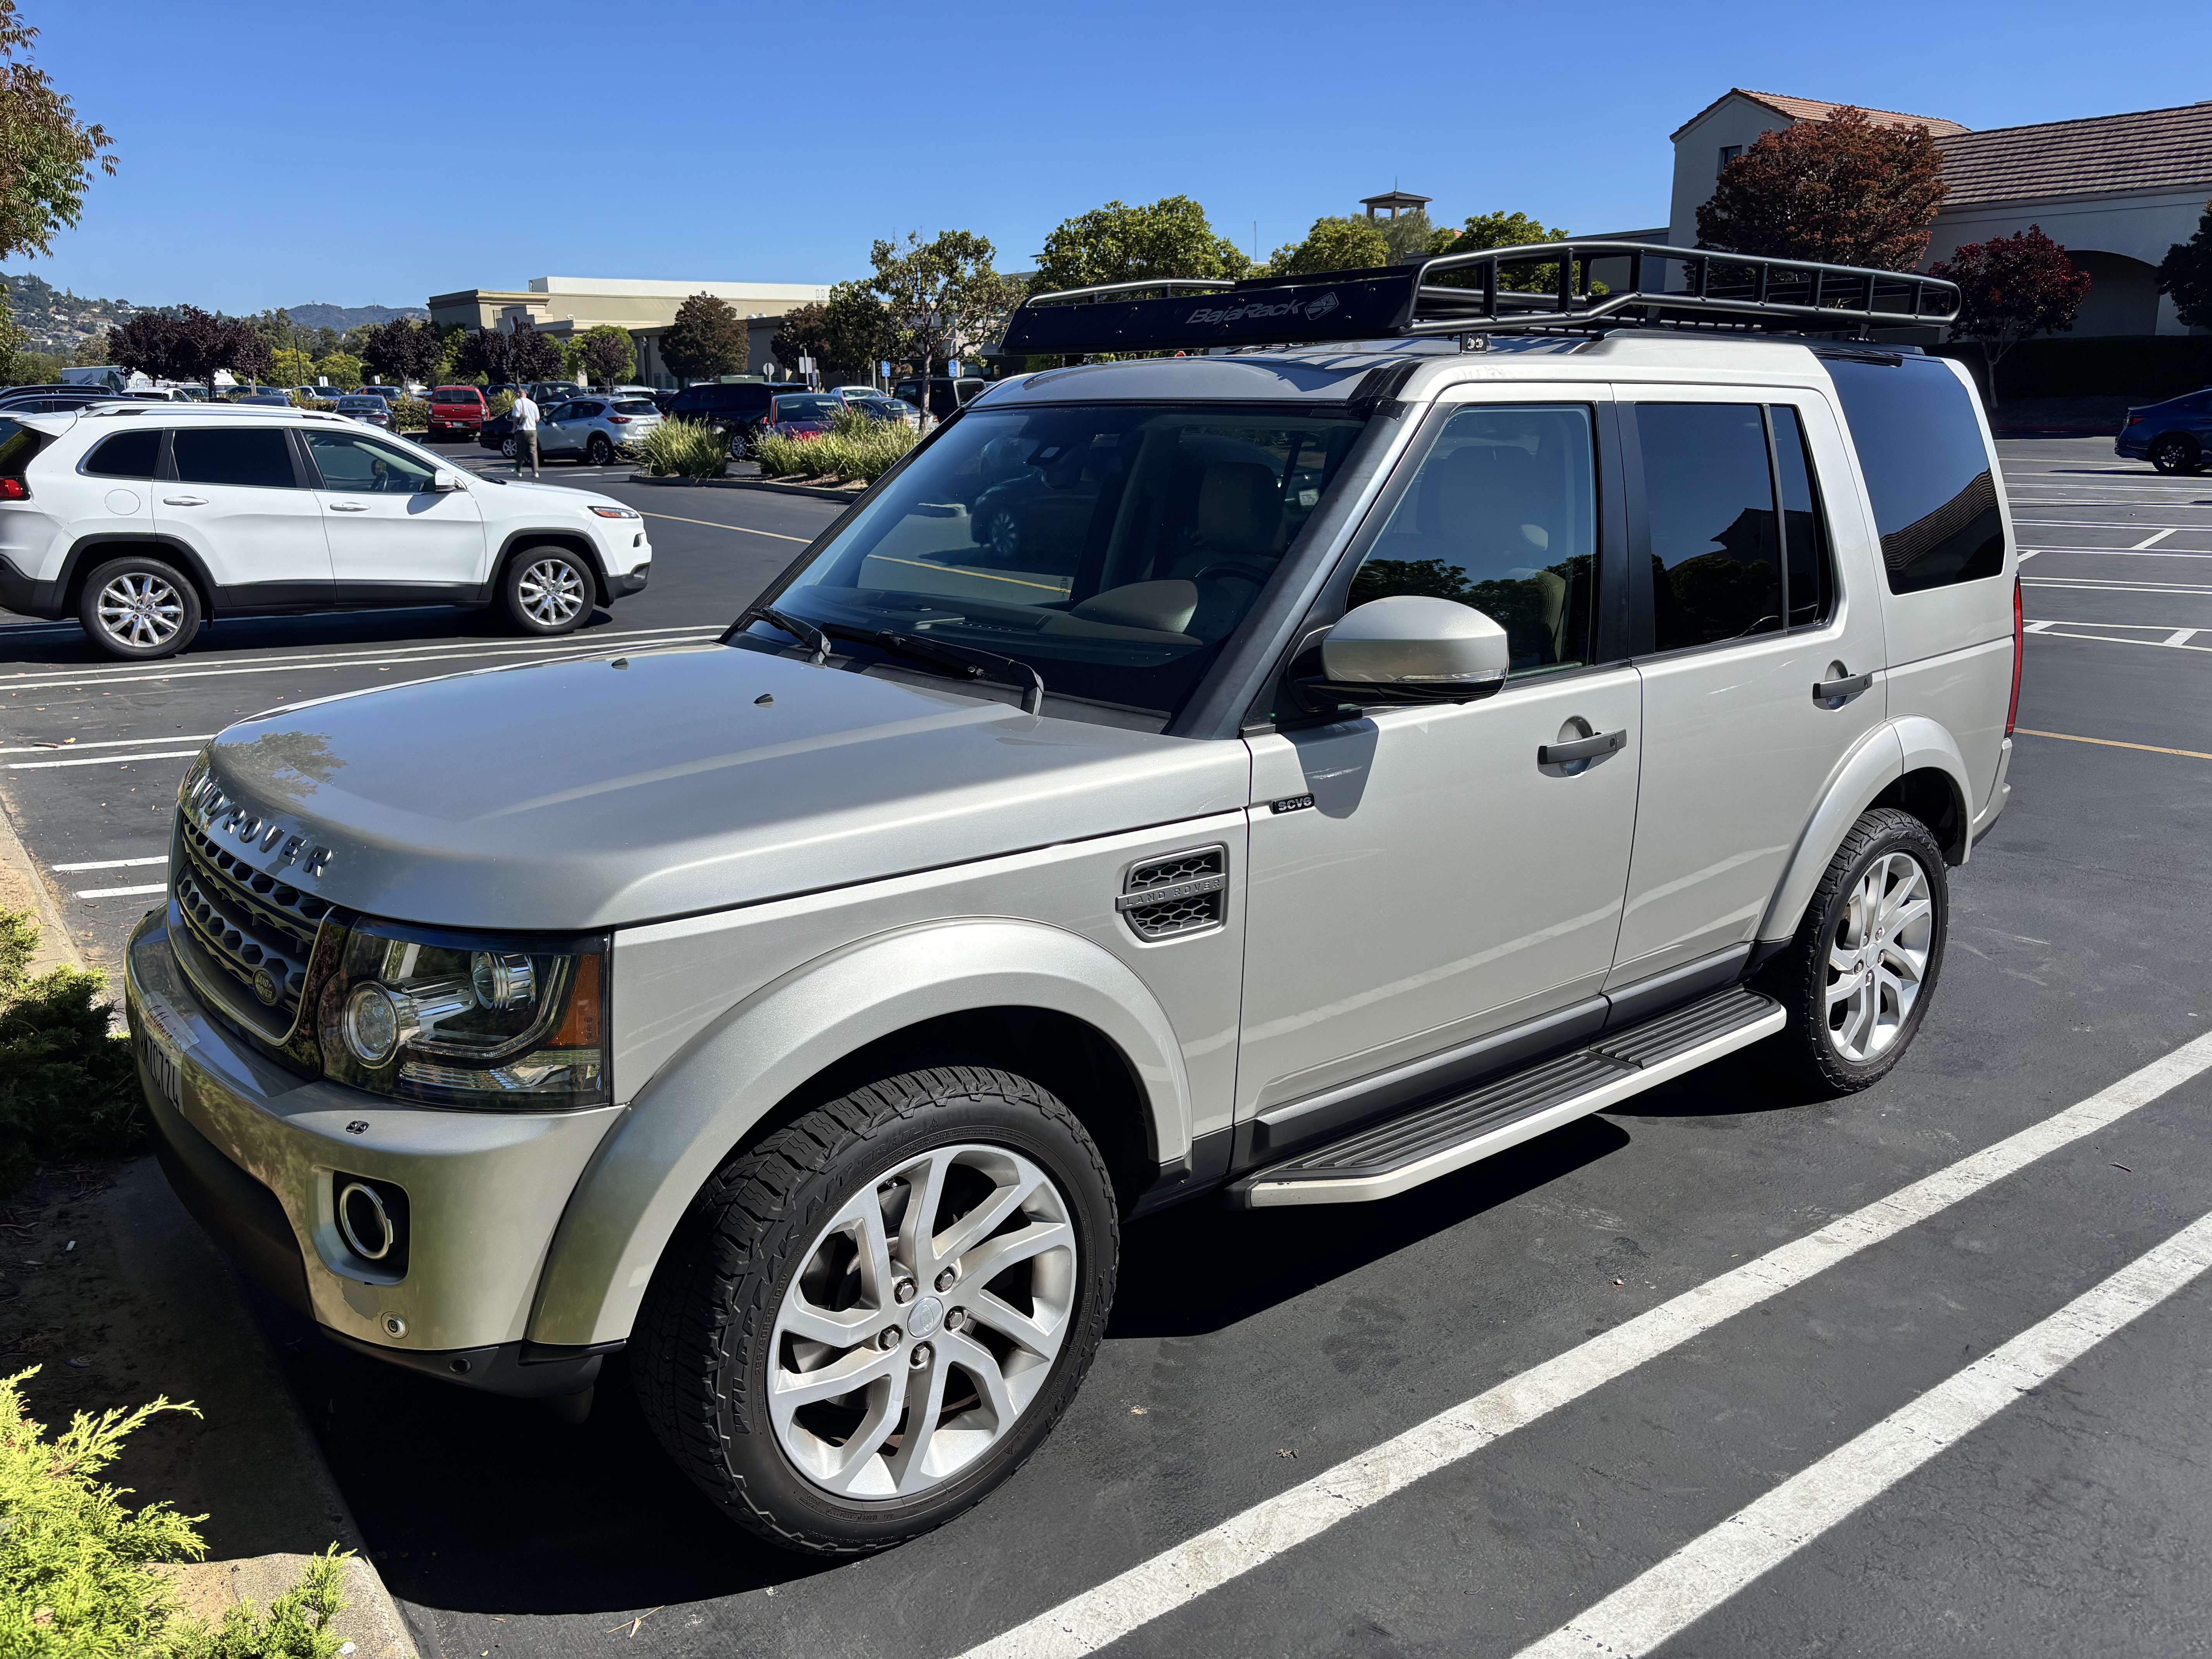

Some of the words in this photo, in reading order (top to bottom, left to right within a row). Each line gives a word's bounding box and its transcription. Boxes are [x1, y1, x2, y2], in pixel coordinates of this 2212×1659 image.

[1186, 299, 1307, 325] BajaRack
[1278, 797, 1312, 811] SCV6
[222, 805, 333, 877] ROVER
[1126, 891, 1165, 907] LAND
[1173, 879, 1221, 896] ROVER
[256, 974, 269, 987] LAND
[256, 984, 273, 999] ROVER
[732, 1221, 799, 1433] WILDPEAK
